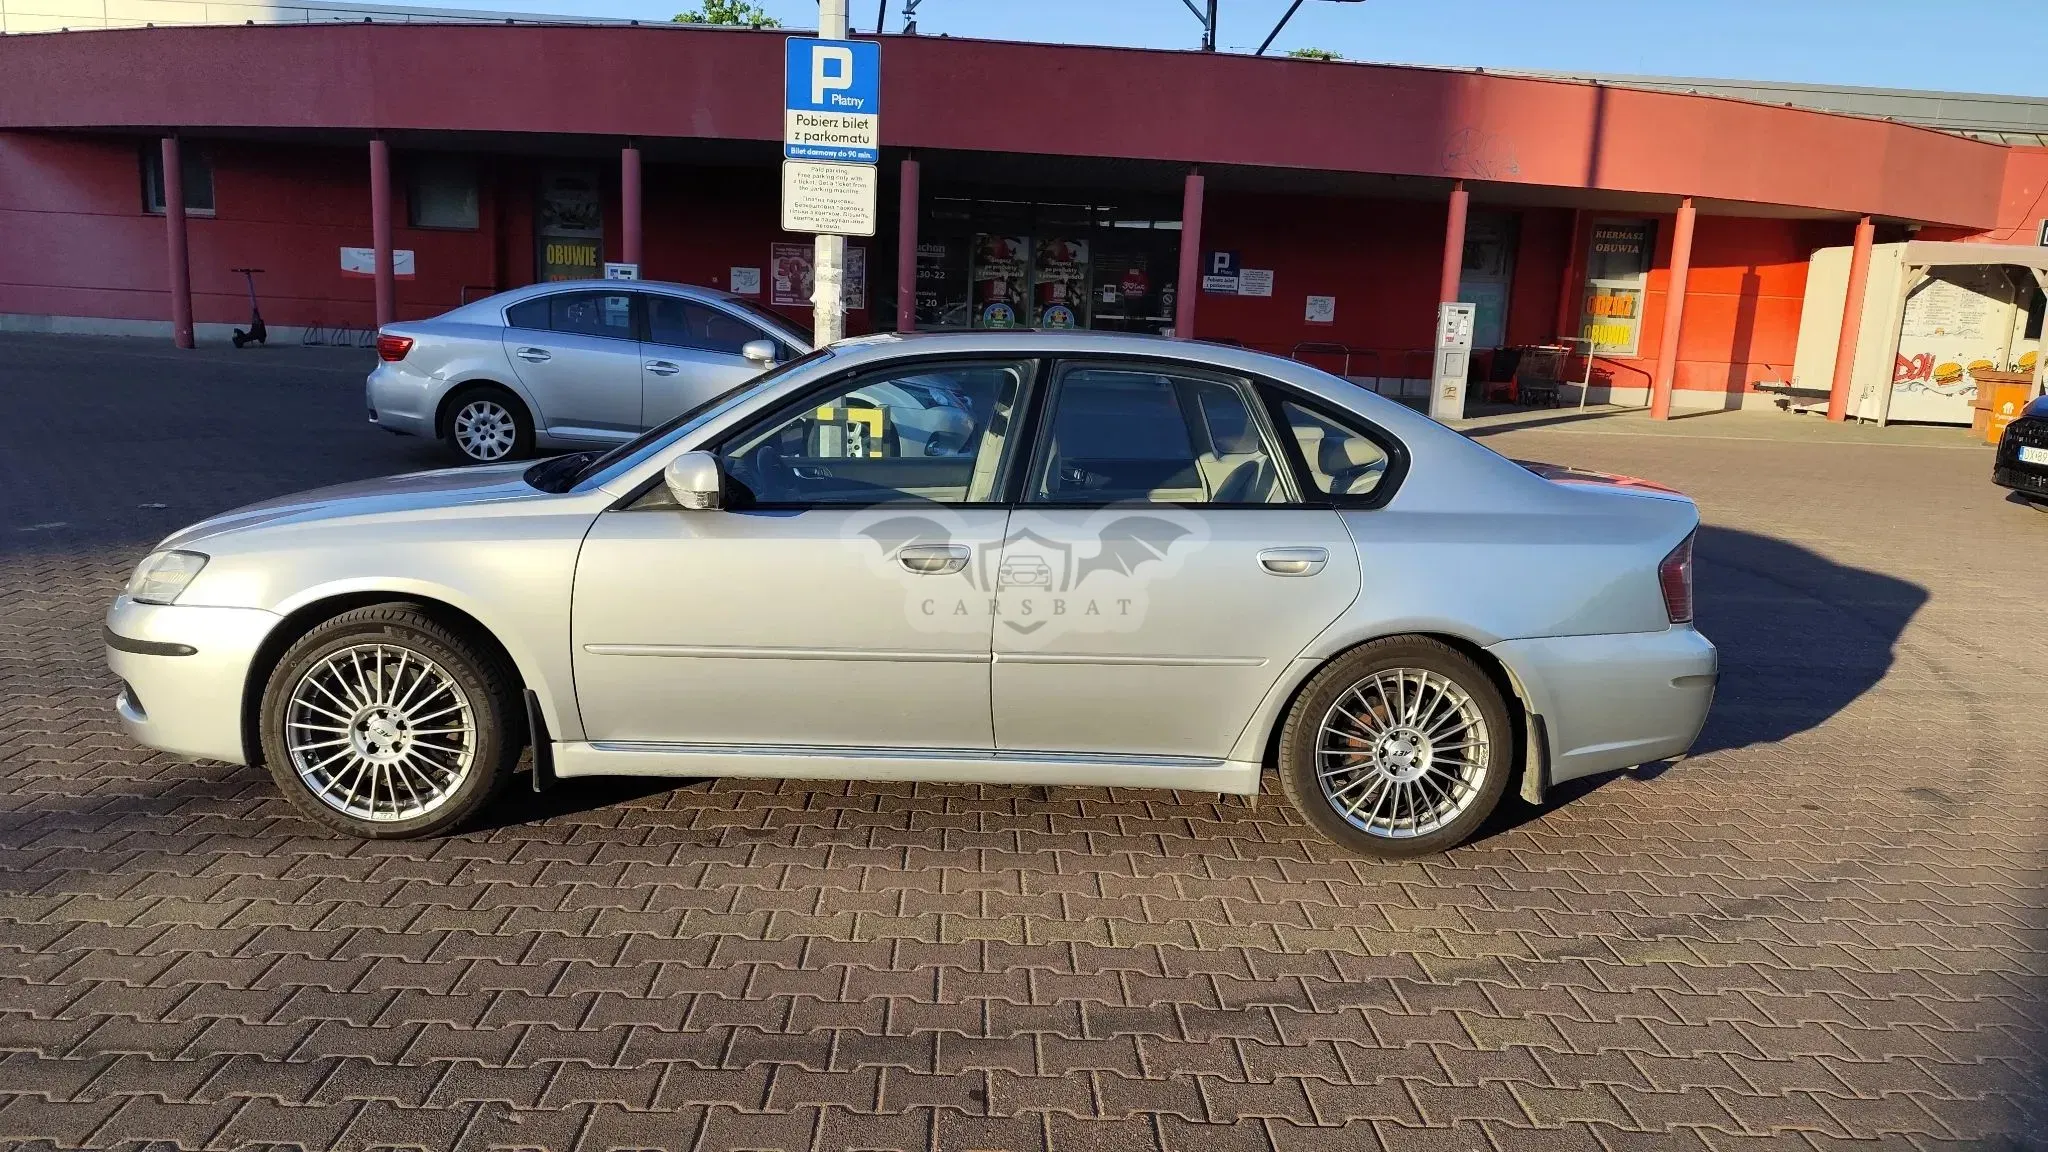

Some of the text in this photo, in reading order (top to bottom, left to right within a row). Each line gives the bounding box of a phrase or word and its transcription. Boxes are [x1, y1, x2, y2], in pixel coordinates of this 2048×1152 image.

[812, 45, 853, 104] P
[831, 93, 864, 109] Płatny
[796, 114, 869, 130] Pobierz bilet
[794, 130, 870, 144] z parkomatu
[790, 147, 806, 155] Bilet
[807, 148, 837, 159] darmowy
[838, 149, 847, 157] do
[1595, 230, 1645, 241] KIERMASZ
[546, 243, 597, 267] OBUWIE
[1595, 243, 1640, 254] OBUWIA
[1213, 252, 1231, 274] P
